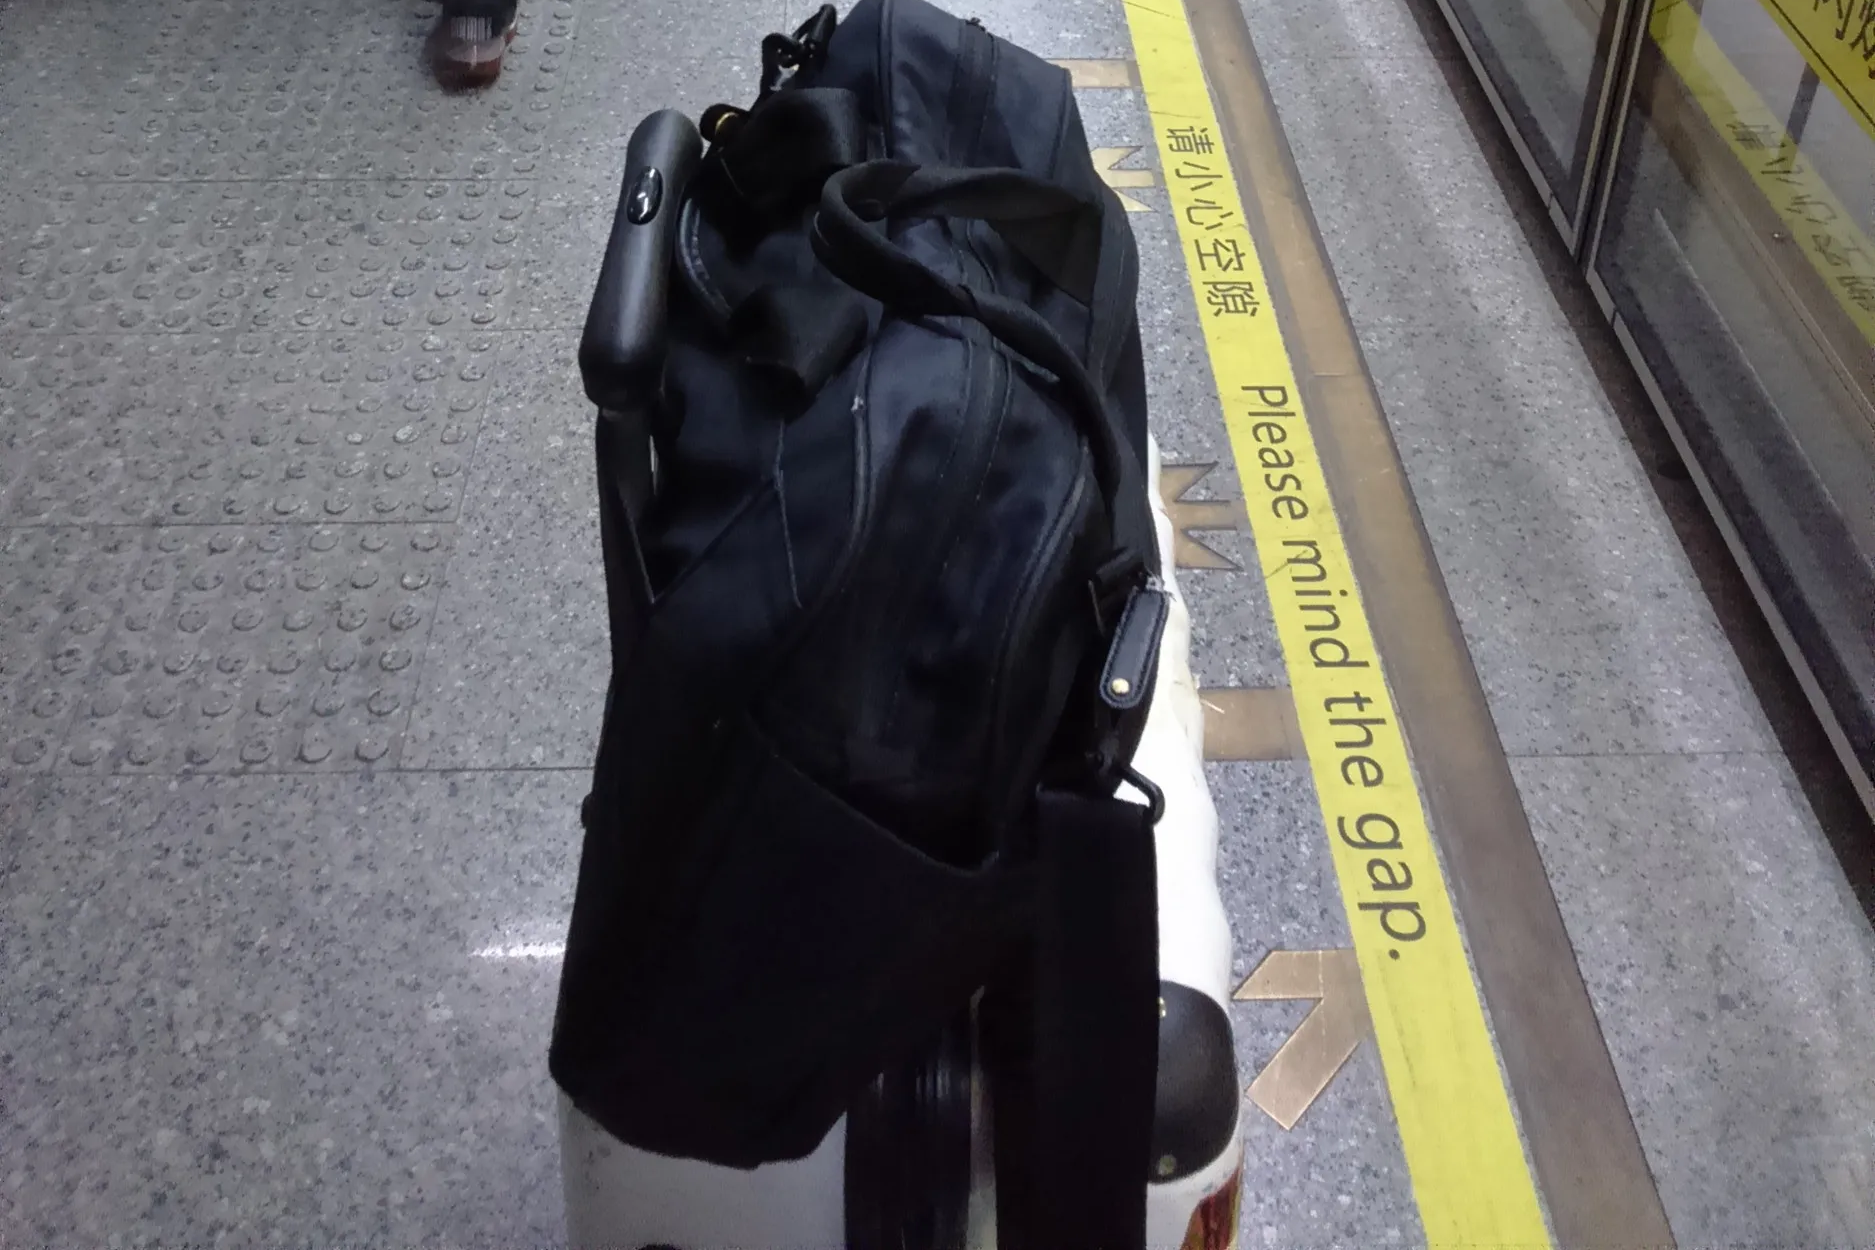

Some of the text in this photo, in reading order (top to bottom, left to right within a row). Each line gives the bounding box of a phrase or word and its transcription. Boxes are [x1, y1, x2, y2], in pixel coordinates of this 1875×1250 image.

[1166, 126, 1260, 317] 请小心空隙
[1241, 385, 1426, 960] Please mind the gap.
